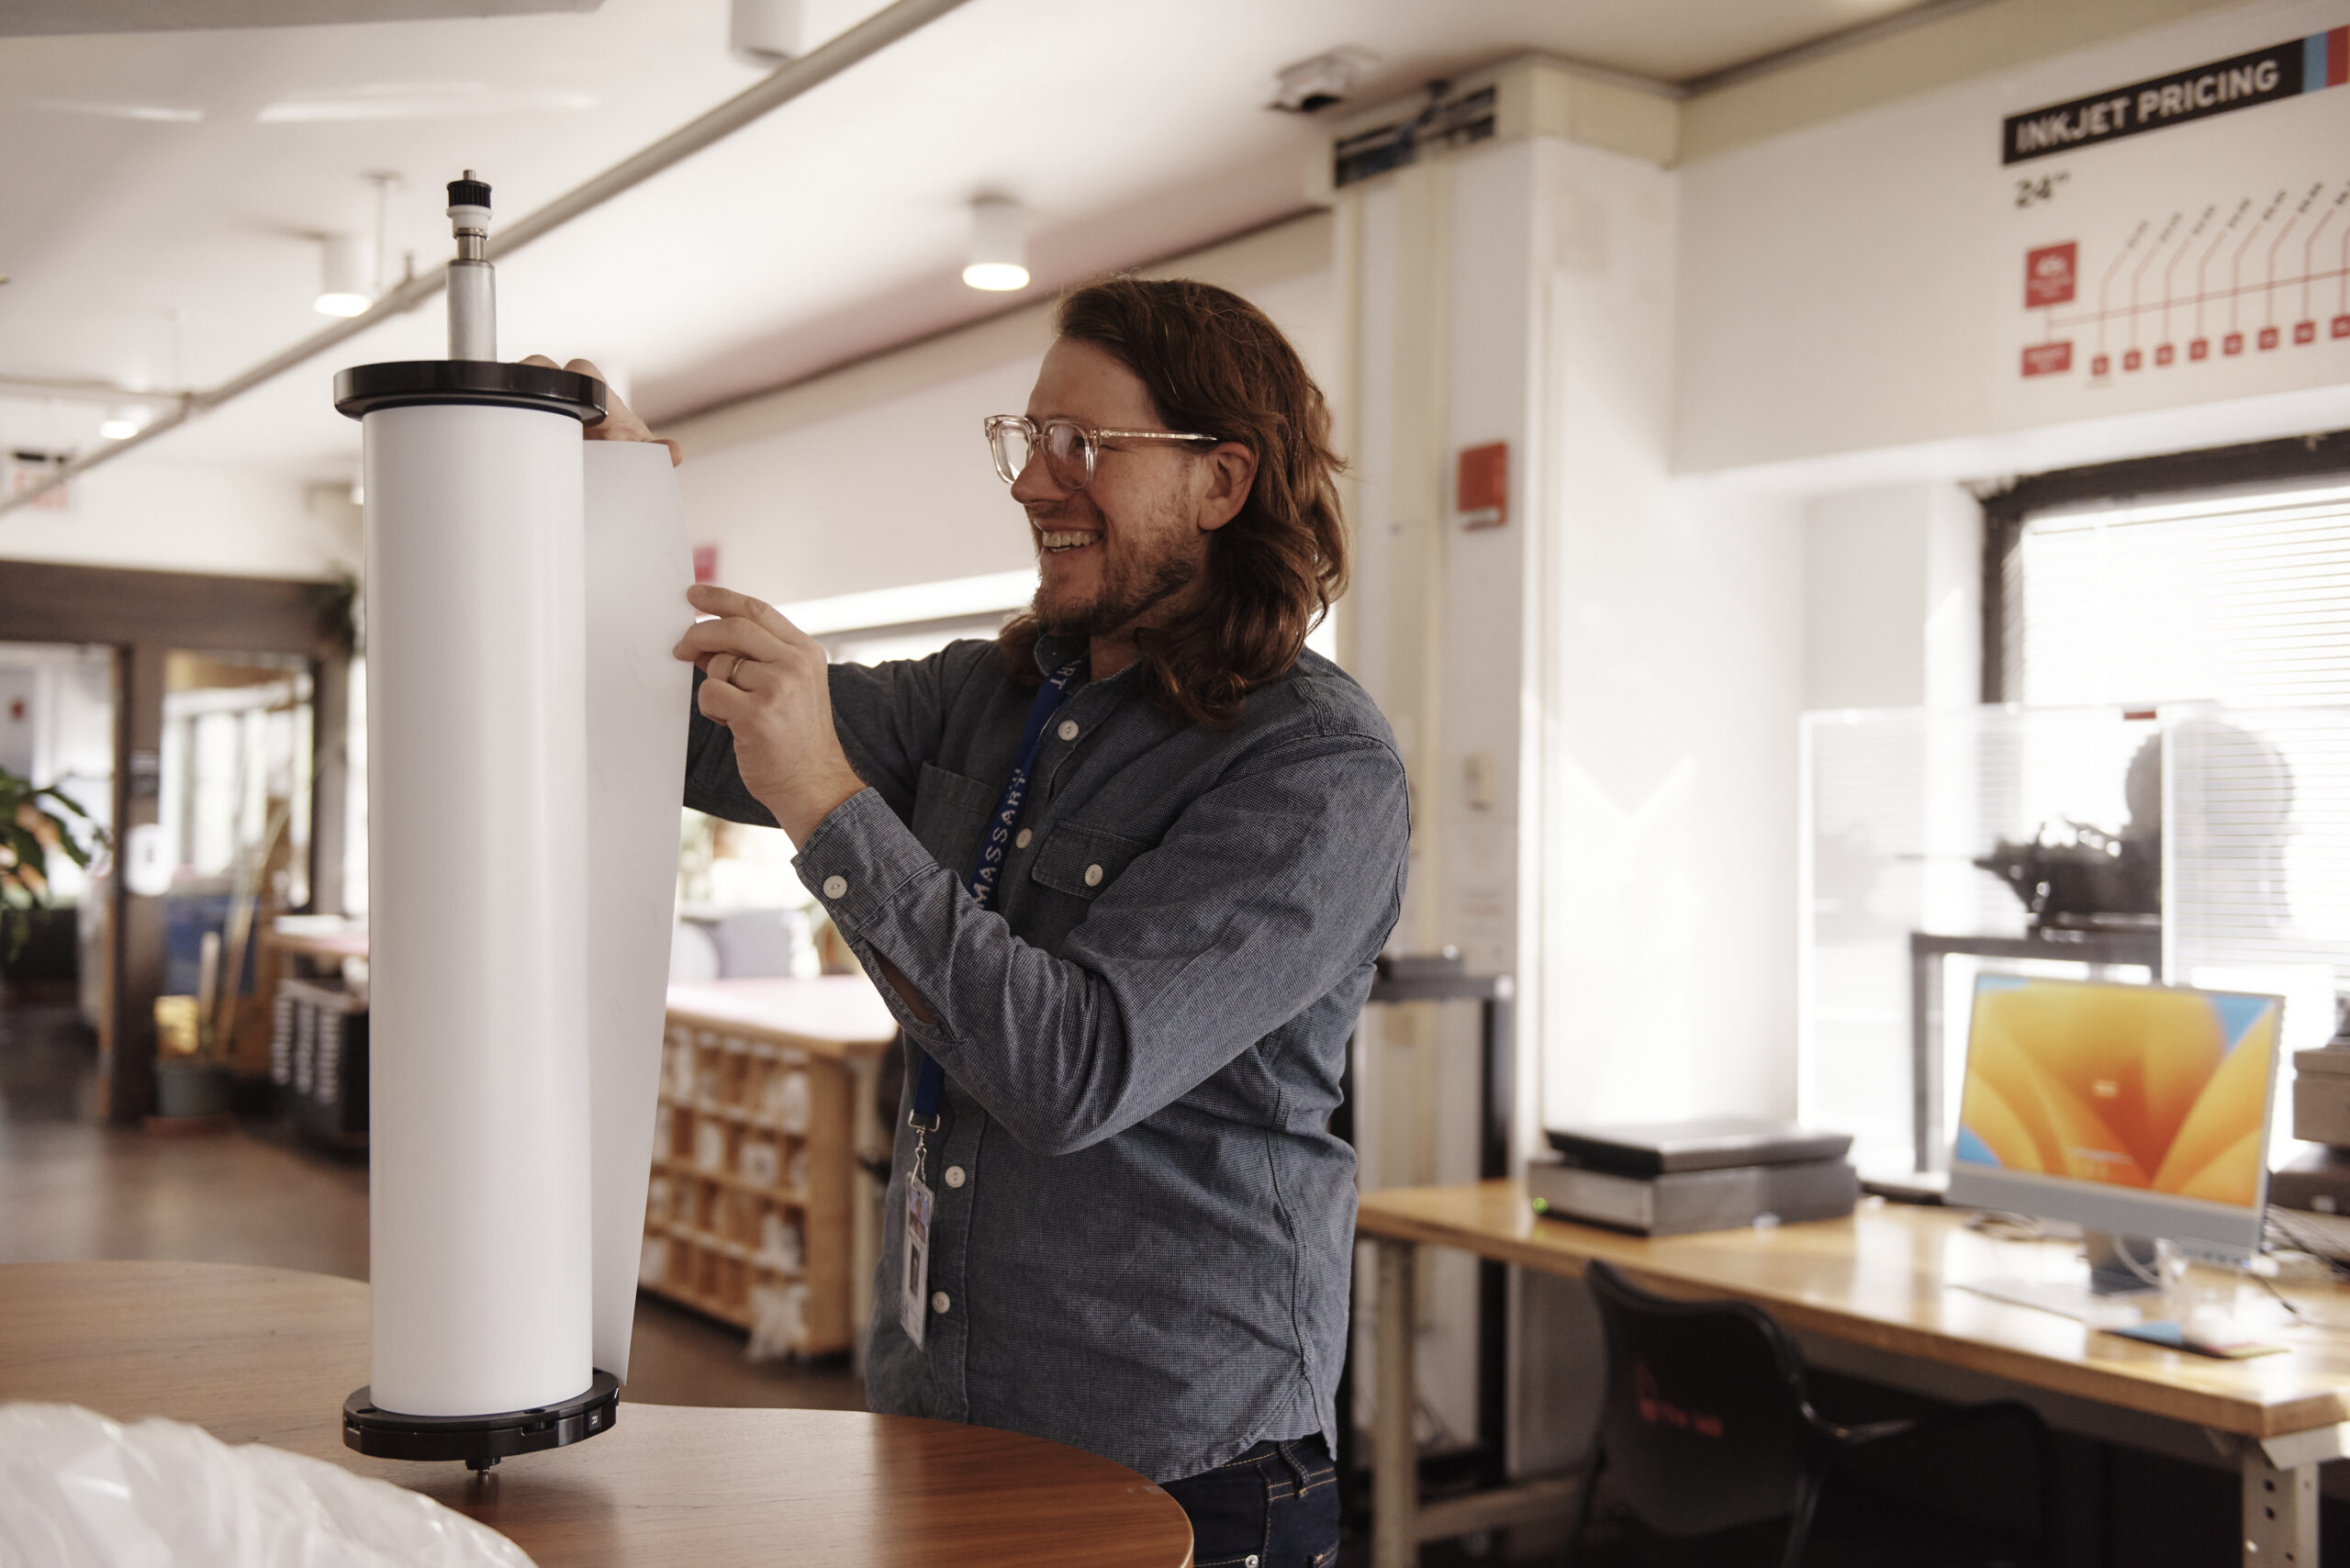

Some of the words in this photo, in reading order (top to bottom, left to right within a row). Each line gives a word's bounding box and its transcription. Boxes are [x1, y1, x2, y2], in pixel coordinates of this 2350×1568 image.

[2015, 95, 2132, 152] INKJET
[2136, 59, 2280, 123] PRICING
[590, 1415, 599, 1426] R
